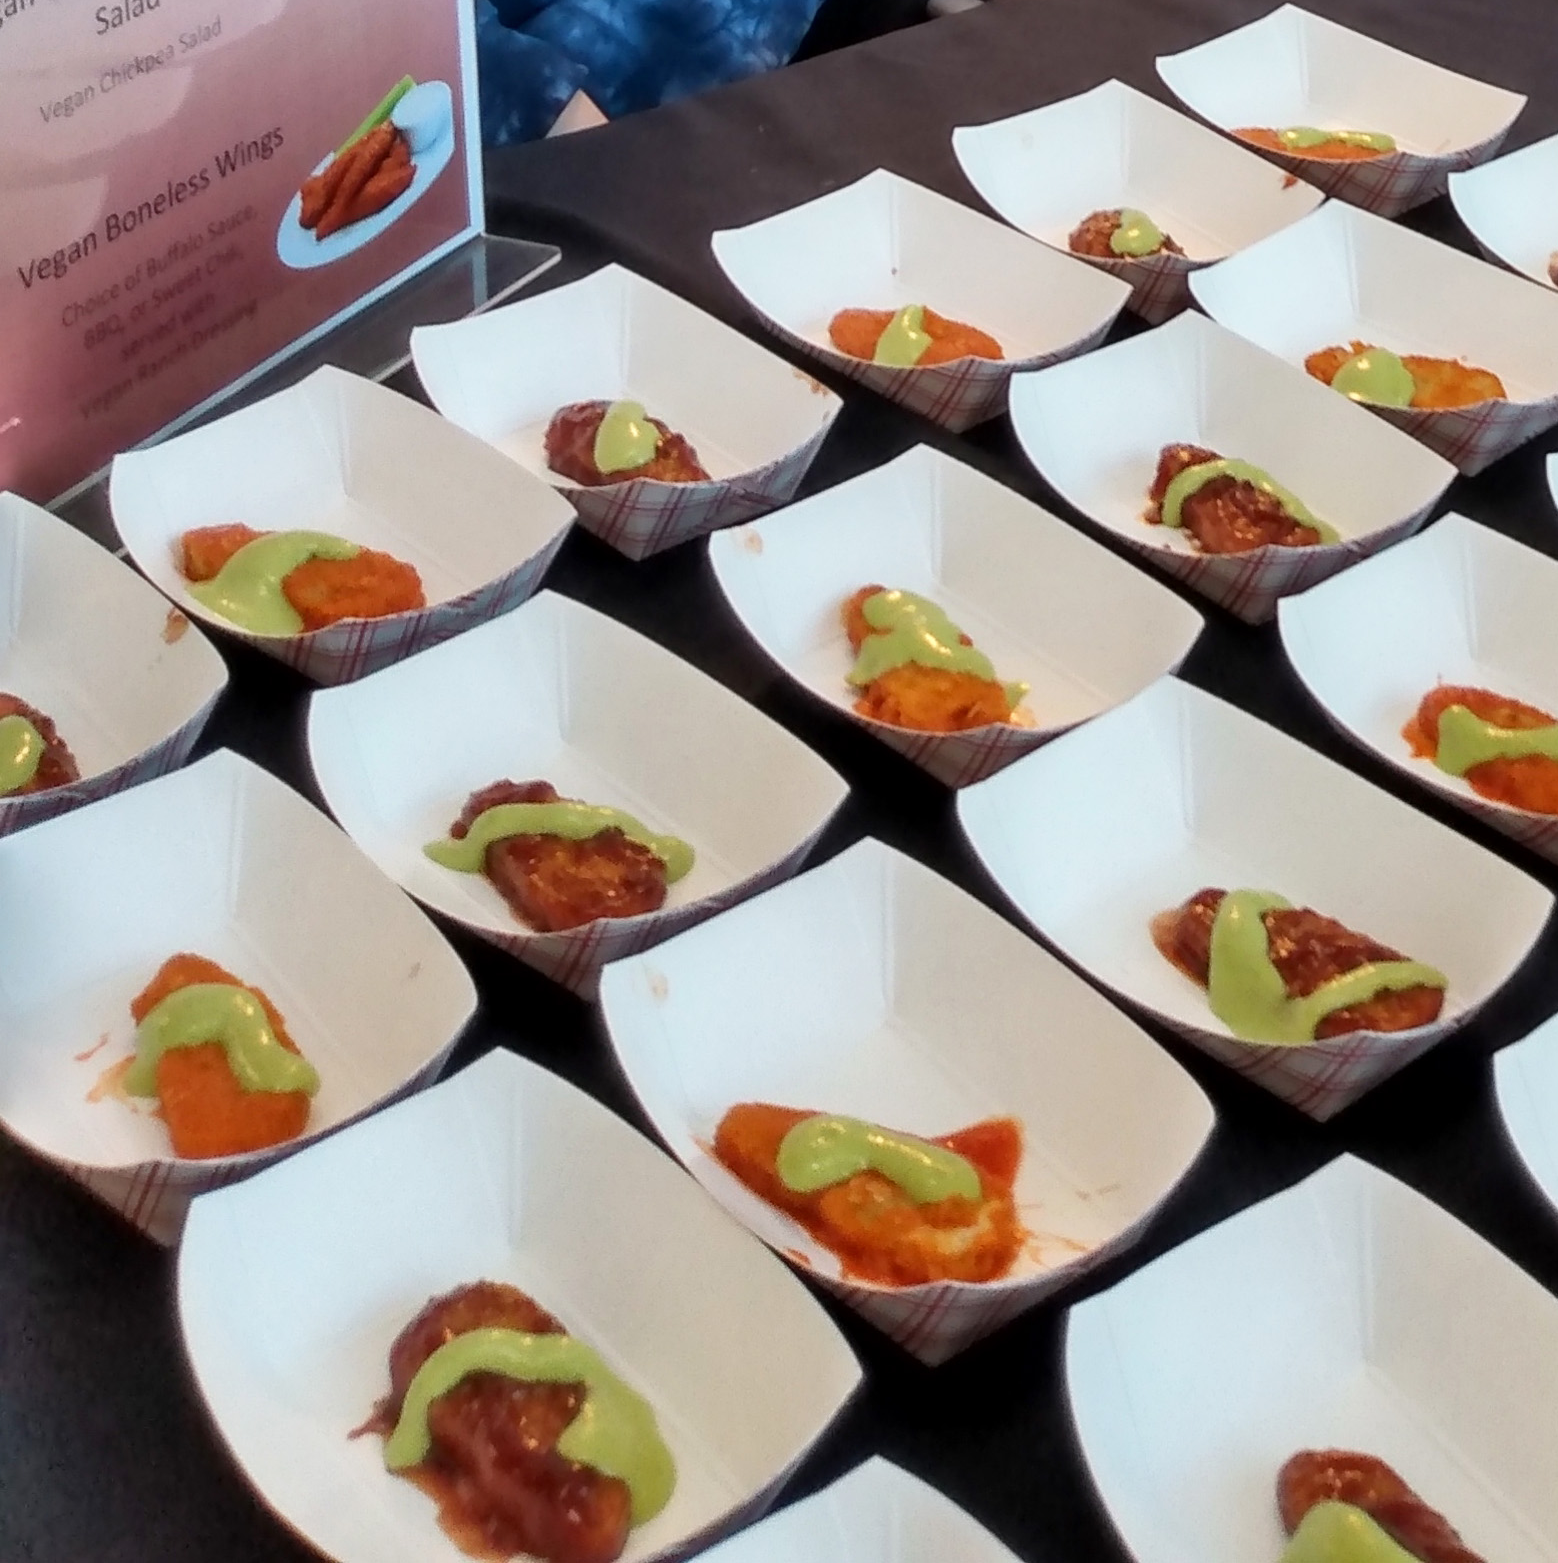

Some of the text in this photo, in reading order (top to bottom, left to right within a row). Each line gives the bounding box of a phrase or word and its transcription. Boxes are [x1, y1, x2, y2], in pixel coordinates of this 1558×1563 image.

[39, 14, 222, 124] Vegan Chickpea Salad
[17, 126, 285, 290] Vegan Boneless Wings
[62, 283, 120, 328] Choice
[124, 266, 143, 292] of
